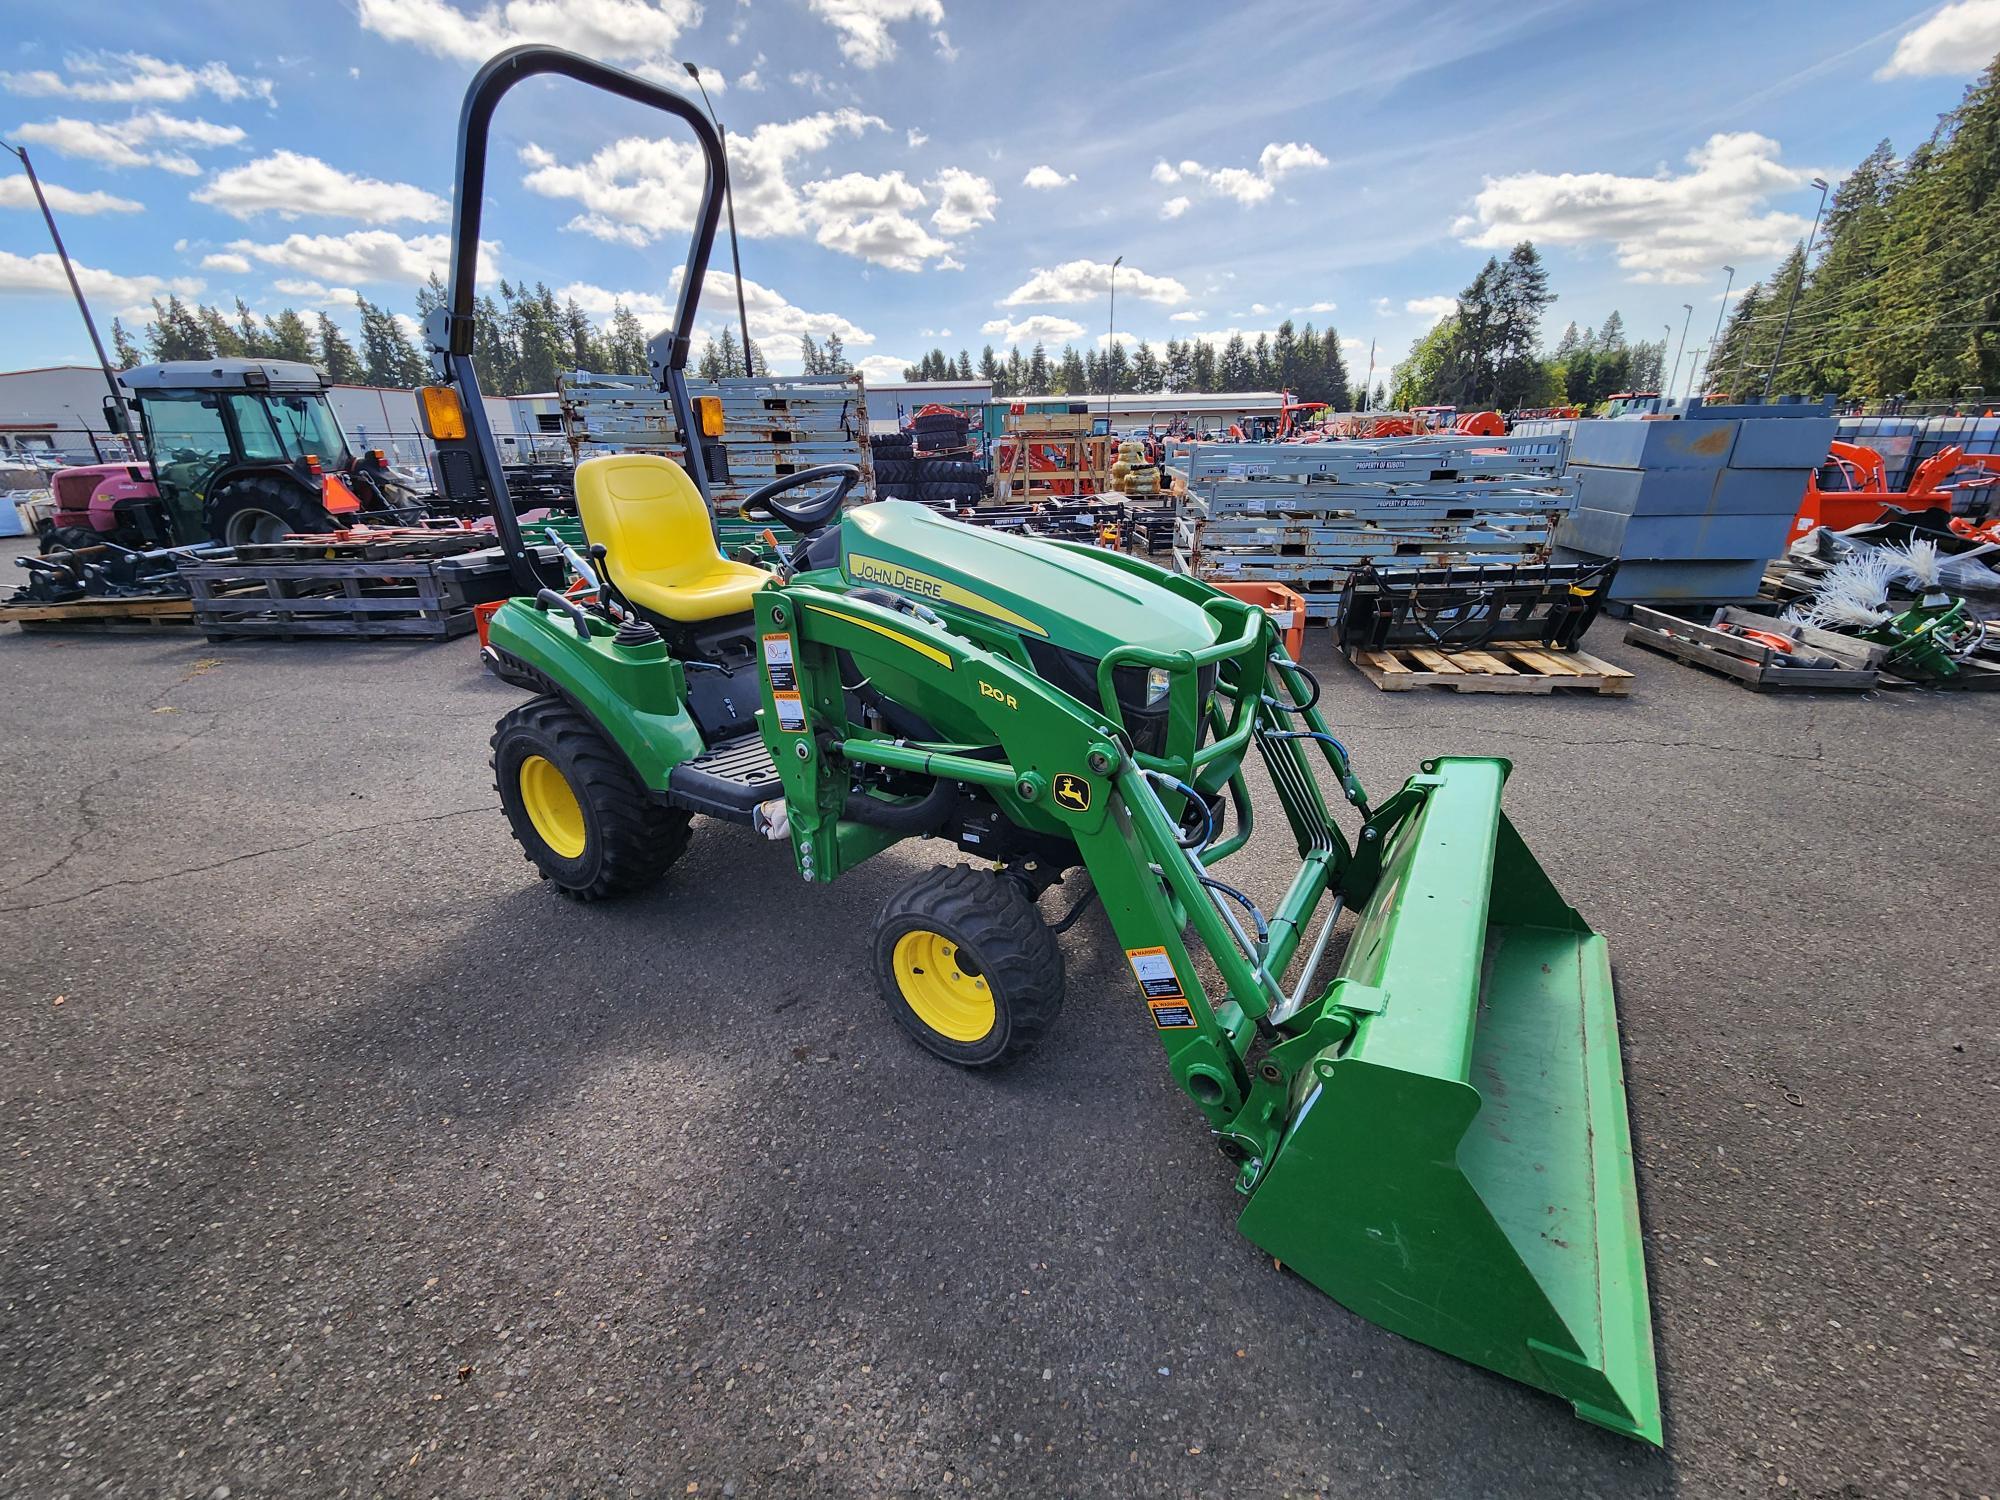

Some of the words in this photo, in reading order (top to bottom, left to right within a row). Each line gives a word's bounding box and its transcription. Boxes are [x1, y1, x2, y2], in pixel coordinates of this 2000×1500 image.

[1356, 461, 1379, 470] PROPERTY
[1387, 461, 1405, 469] KUBOTA
[1377, 499, 1400, 507] PROPERTY
[857, 562, 892, 584] JOHN
[894, 570, 942, 597] DEERE
[1137, 948, 1162, 956] WARNING
